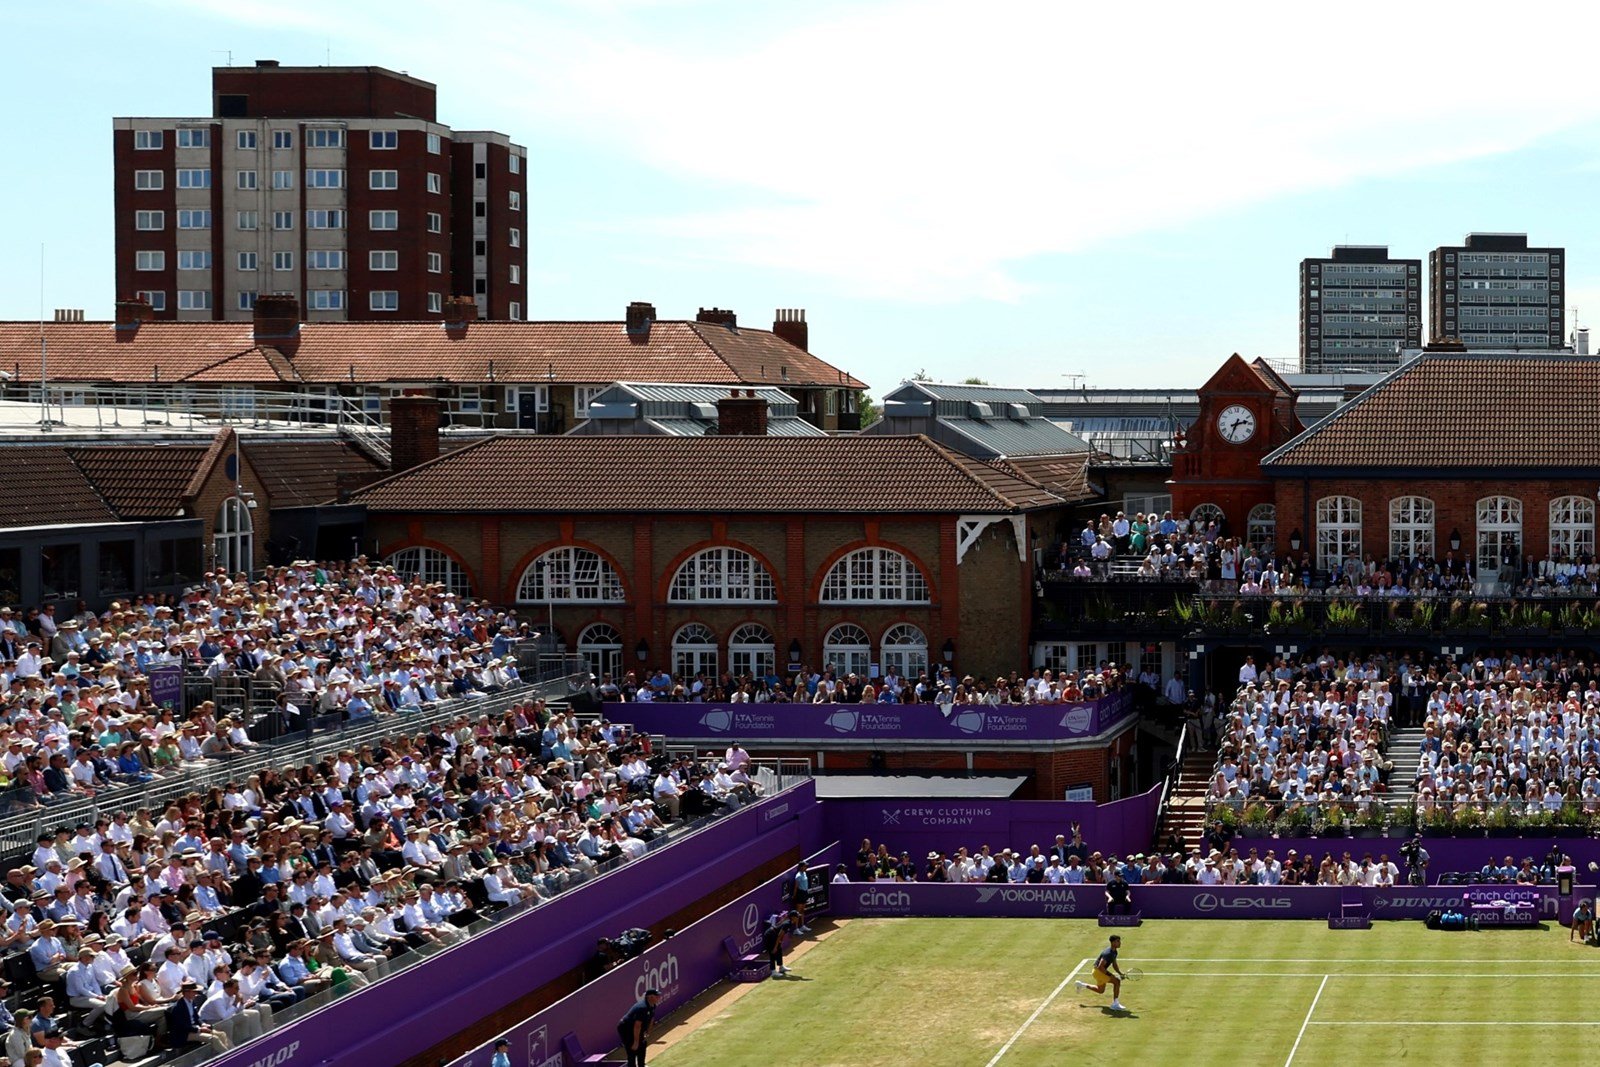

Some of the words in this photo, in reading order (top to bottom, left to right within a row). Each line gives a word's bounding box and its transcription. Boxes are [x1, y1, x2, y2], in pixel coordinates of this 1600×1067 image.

[154, 673, 180, 689] cinch
[736, 714, 752, 722] LTA
[752, 714, 774, 722] Tennis
[862, 715, 878, 723] LTA
[987, 716, 1004, 724] LTA
[1004, 716, 1026, 724] Tennis
[862, 722, 900, 730] Foundation
[904, 808, 934, 816] CREW
[938, 808, 992, 816] CLOTHING
[860, 887, 910, 906] cinch
[1000, 890, 1076, 902] YOKOHAMA
[1470, 889, 1500, 900] cinch
[1504, 889, 1534, 900] cinch
[1044, 904, 1076, 912] TYRES
[1221, 898, 1291, 908] LEXUS
[1472, 910, 1499, 920] cinch
[1504, 911, 1532, 920] cinch
[739, 933, 762, 955] LEXUS
[635, 953, 678, 1004] cinch
